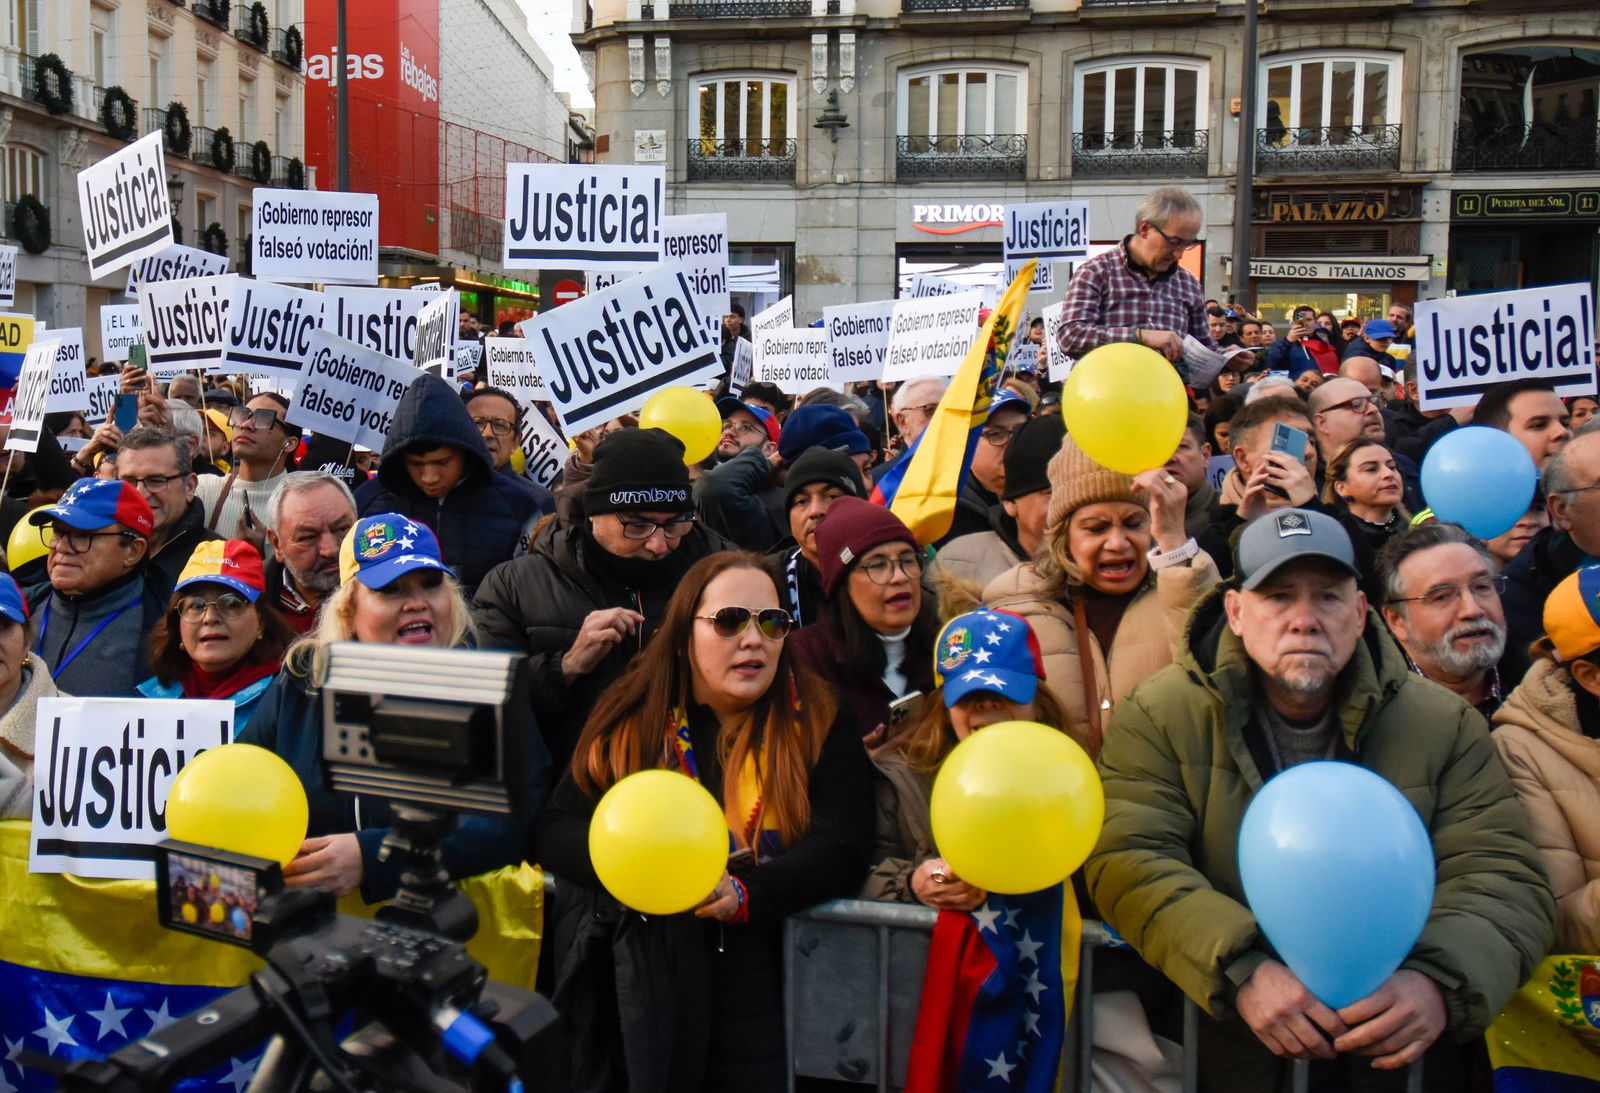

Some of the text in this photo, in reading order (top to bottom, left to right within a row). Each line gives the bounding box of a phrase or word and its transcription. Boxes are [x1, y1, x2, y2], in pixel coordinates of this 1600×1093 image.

[400, 55, 437, 102] rebajas
[87, 144, 167, 250] Justicia!
[510, 174, 660, 244] Justicia!
[258, 201, 373, 232] ¡Gobierno represor
[913, 204, 1004, 222] PRIMOR
[1273, 201, 1386, 222] PALAZZO
[1006, 207, 1087, 250] Justicia!
[258, 235, 373, 261] falseó votación!
[664, 233, 723, 261] represor
[1250, 264, 1406, 279] HELADOS ITALIANOS
[829, 315, 883, 342] ¡Gobierno
[892, 306, 977, 340] ¡Gobierno represor
[108, 335, 134, 349] contra
[541, 272, 709, 404] Justicia!
[762, 339, 804, 360] ¡Gobierno
[1423, 295, 1591, 382] Justicia!
[489, 347, 524, 366] ¡Gobierno
[832, 344, 873, 368] falseó
[889, 340, 918, 366] falseó
[308, 347, 386, 393] ¡Gobierno
[491, 370, 517, 388] falseó
[761, 363, 791, 381] falseó
[300, 383, 355, 422] falseó
[610, 487, 687, 505] umbro
